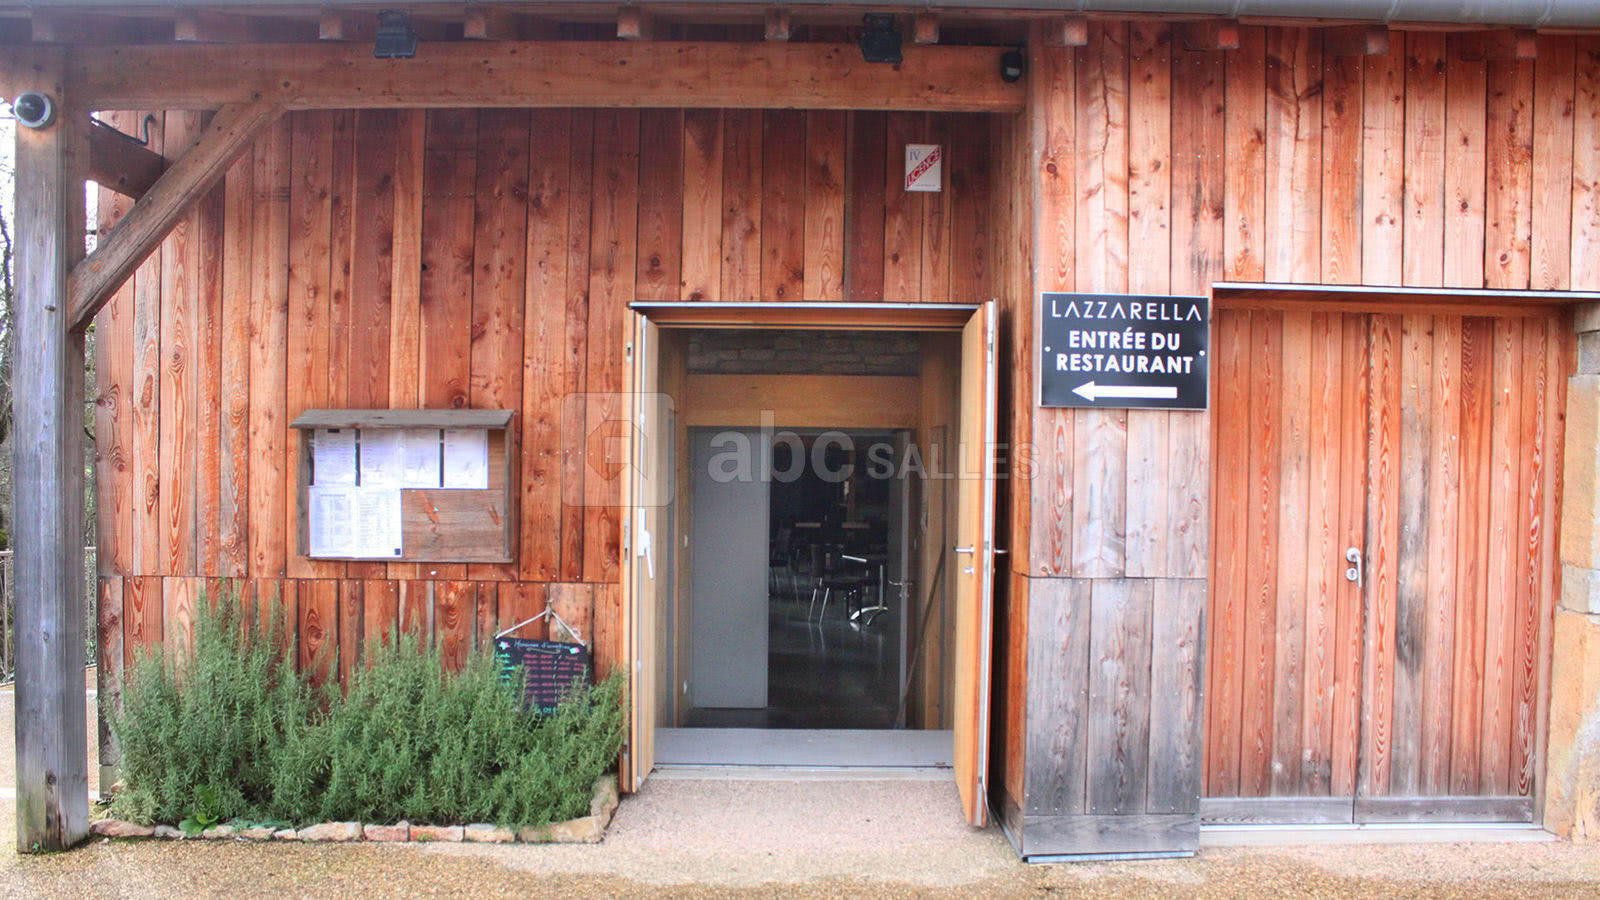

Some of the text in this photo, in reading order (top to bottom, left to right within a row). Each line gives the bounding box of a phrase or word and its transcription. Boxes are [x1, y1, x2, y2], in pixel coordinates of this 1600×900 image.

[909, 151, 920, 160] IV
[906, 146, 940, 187] LICENCE
[1051, 300, 1202, 321] LAZZARELLA
[1069, 327, 1180, 351] ENTRÉE DU
[1056, 353, 1193, 374] RESTAURANT
